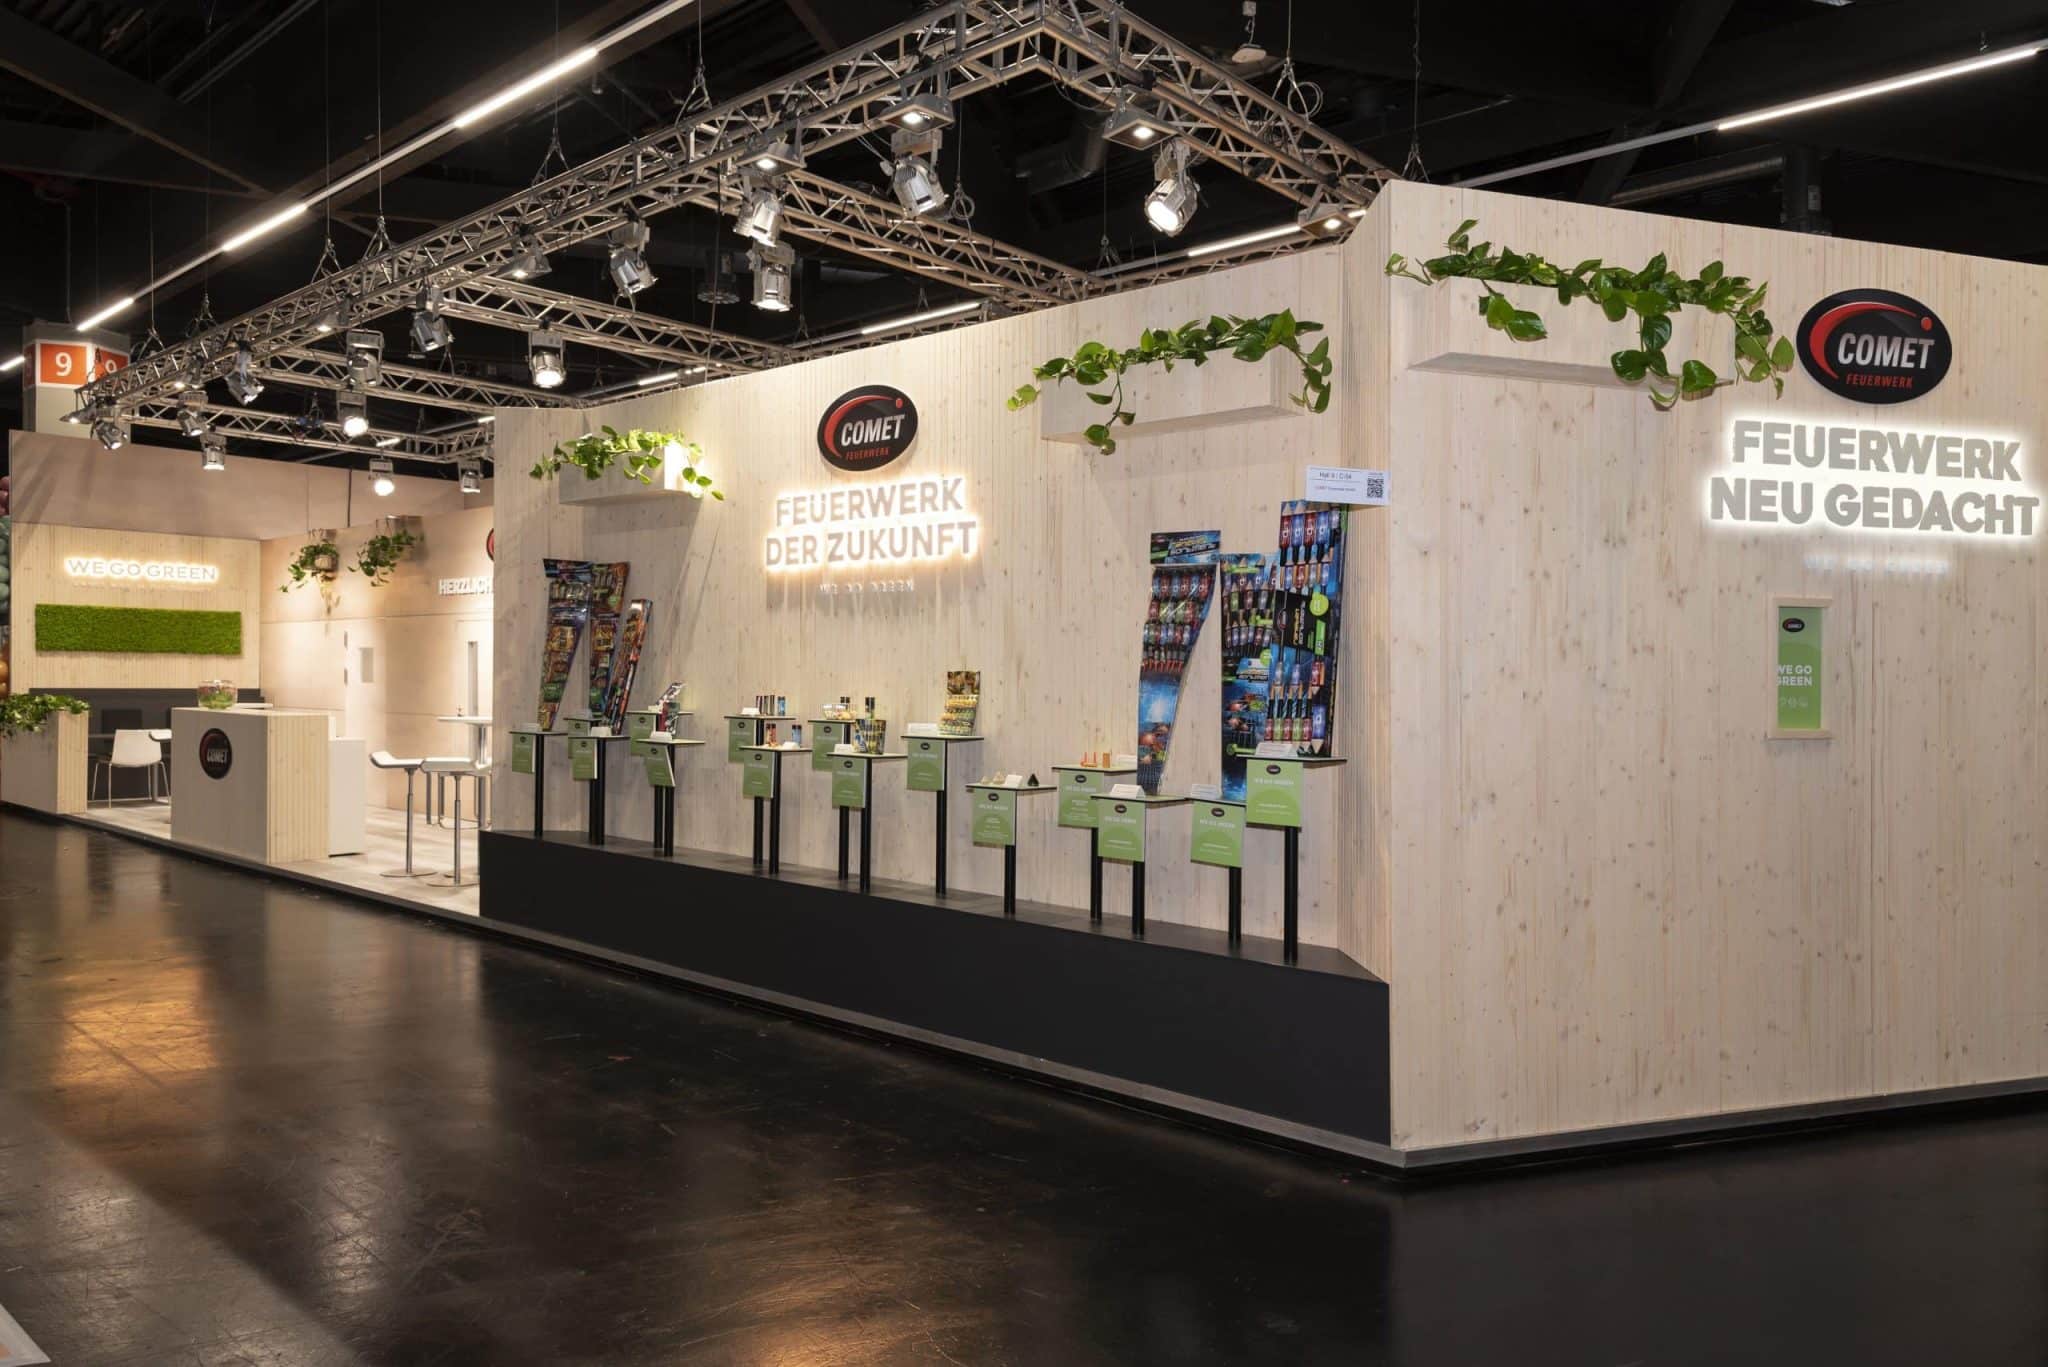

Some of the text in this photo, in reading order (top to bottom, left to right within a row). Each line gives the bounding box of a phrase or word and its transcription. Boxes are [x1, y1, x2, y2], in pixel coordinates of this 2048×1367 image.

[55, 352, 72, 376] 9
[1837, 333, 1935, 369] COMET
[1846, 373, 1913, 389] FEUERWERK
[841, 413, 905, 447] COMET
[846, 447, 890, 460] FEUERWERK
[1732, 419, 2023, 482] FEUERWERK
[776, 478, 963, 527] FEUERWERK
[1710, 477, 2040, 536] NEU GEDACHT
[766, 521, 977, 566] DER ZUKUNFT
[68, 559, 216, 580] WE GO GREEN
[1795, 664, 1812, 674] GO
